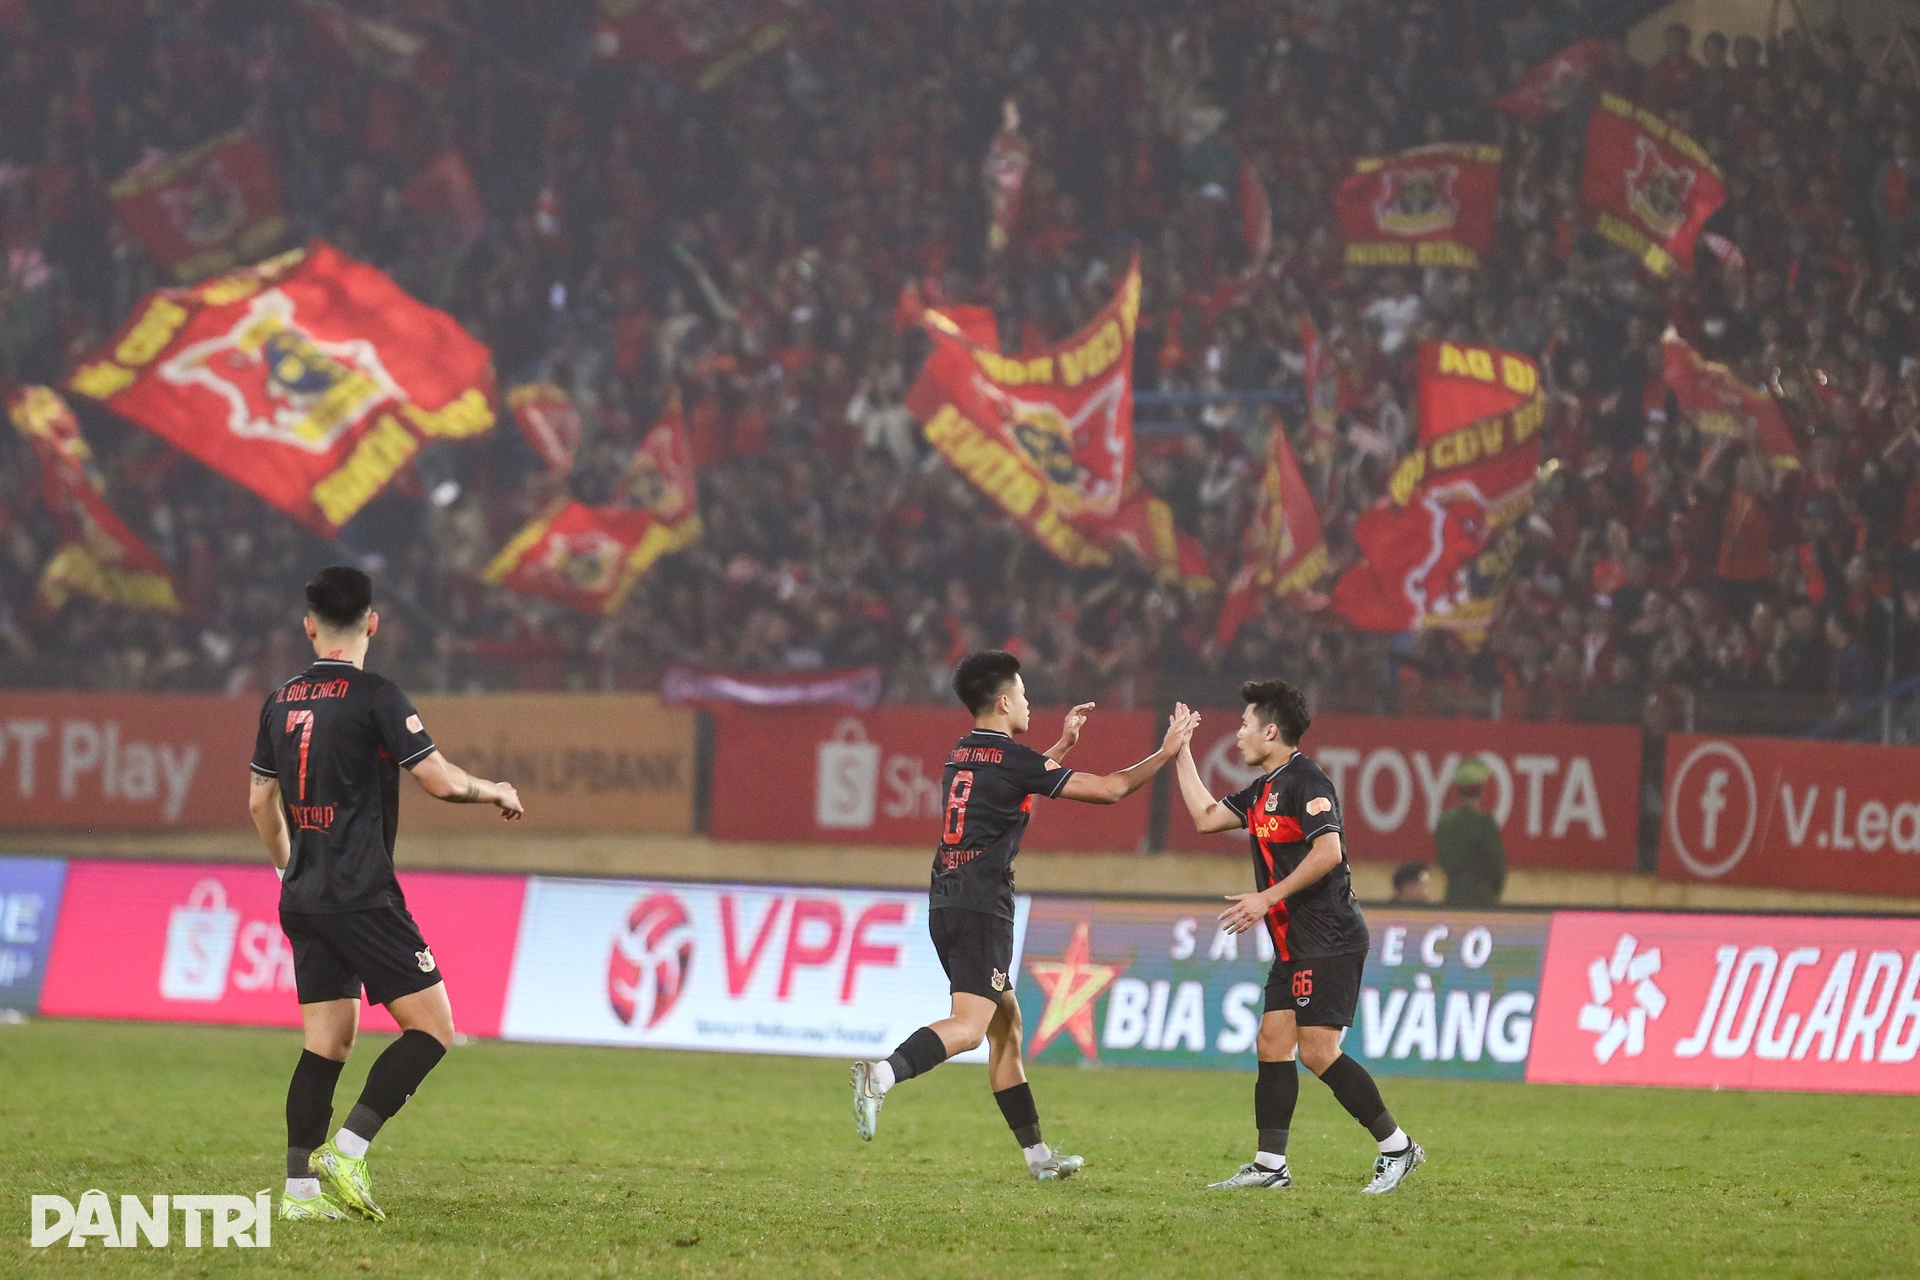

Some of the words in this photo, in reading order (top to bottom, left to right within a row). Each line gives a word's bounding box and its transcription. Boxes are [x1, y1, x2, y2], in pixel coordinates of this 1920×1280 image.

[60, 719, 199, 824] Play
[285, 709, 315, 800] 7
[943, 769, 974, 845] 8
[718, 893, 908, 1003] VPF
[1292, 969, 1313, 997] 66
[1103, 977, 1206, 1053] BIA
[1361, 972, 1535, 1063] VÀNG
